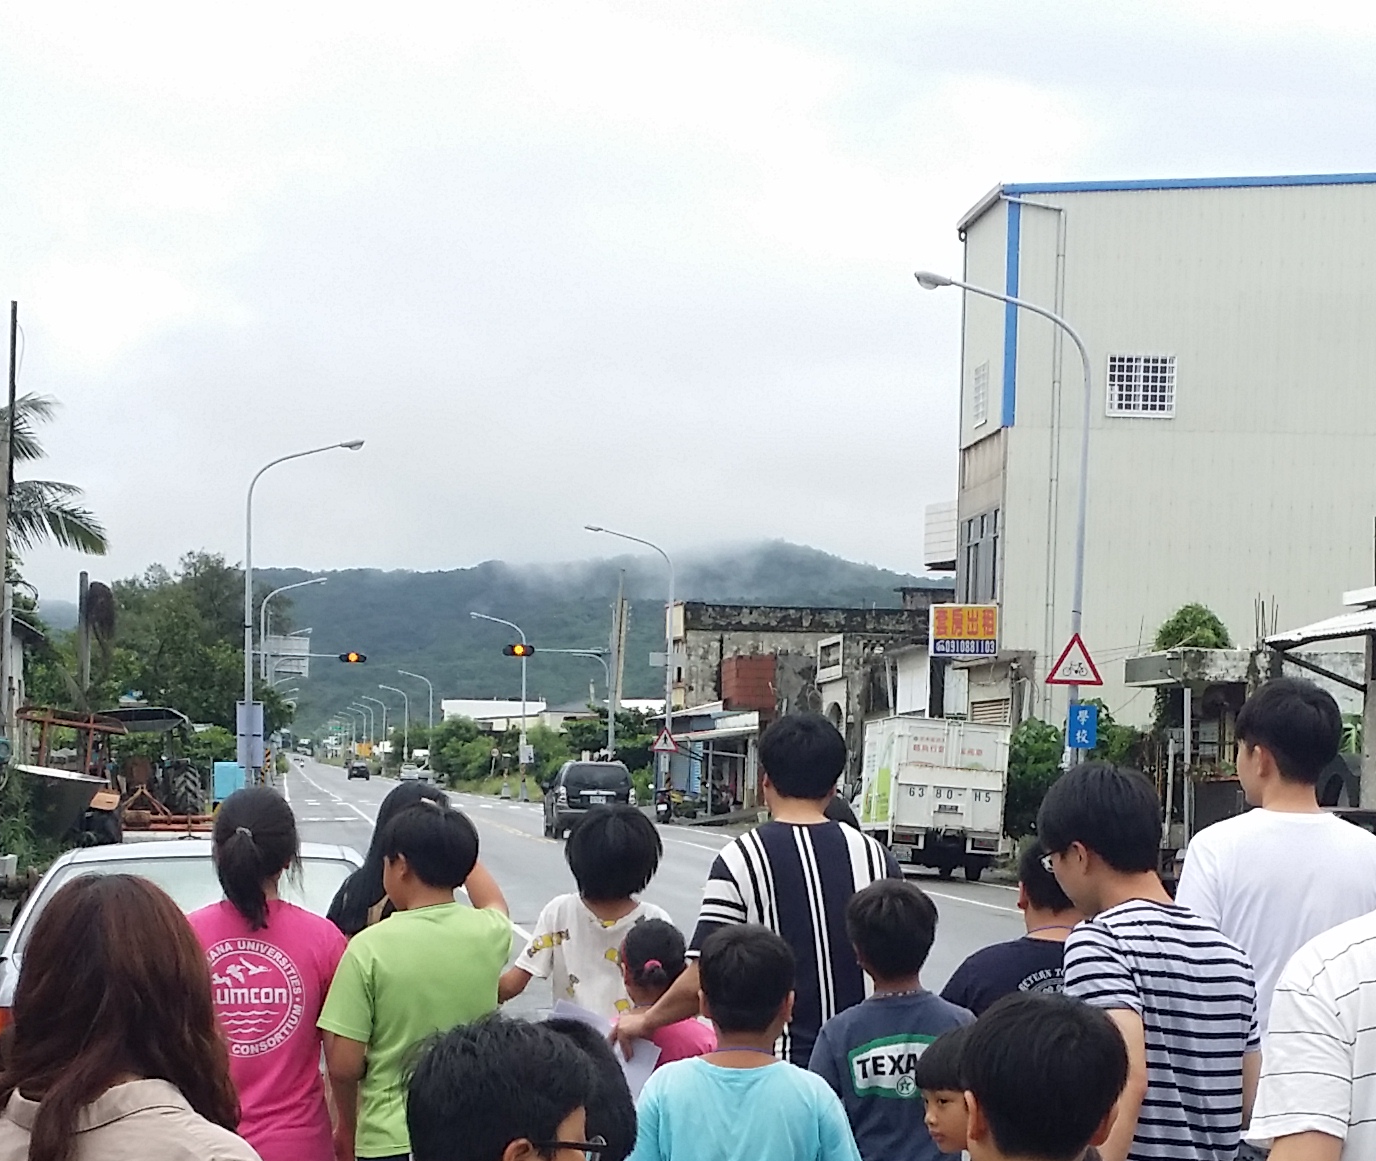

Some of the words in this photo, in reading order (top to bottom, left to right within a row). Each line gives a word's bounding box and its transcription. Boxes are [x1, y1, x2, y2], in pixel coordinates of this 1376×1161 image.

[935, 608, 994, 637] 套房出租
[945, 639, 995, 654] 0910881103
[1075, 709, 1090, 744] 學校
[237, 940, 302, 995] UNIVERSITIES
[214, 987, 287, 1005] umcon
[231, 1004, 303, 1055] CONSORTIUM
